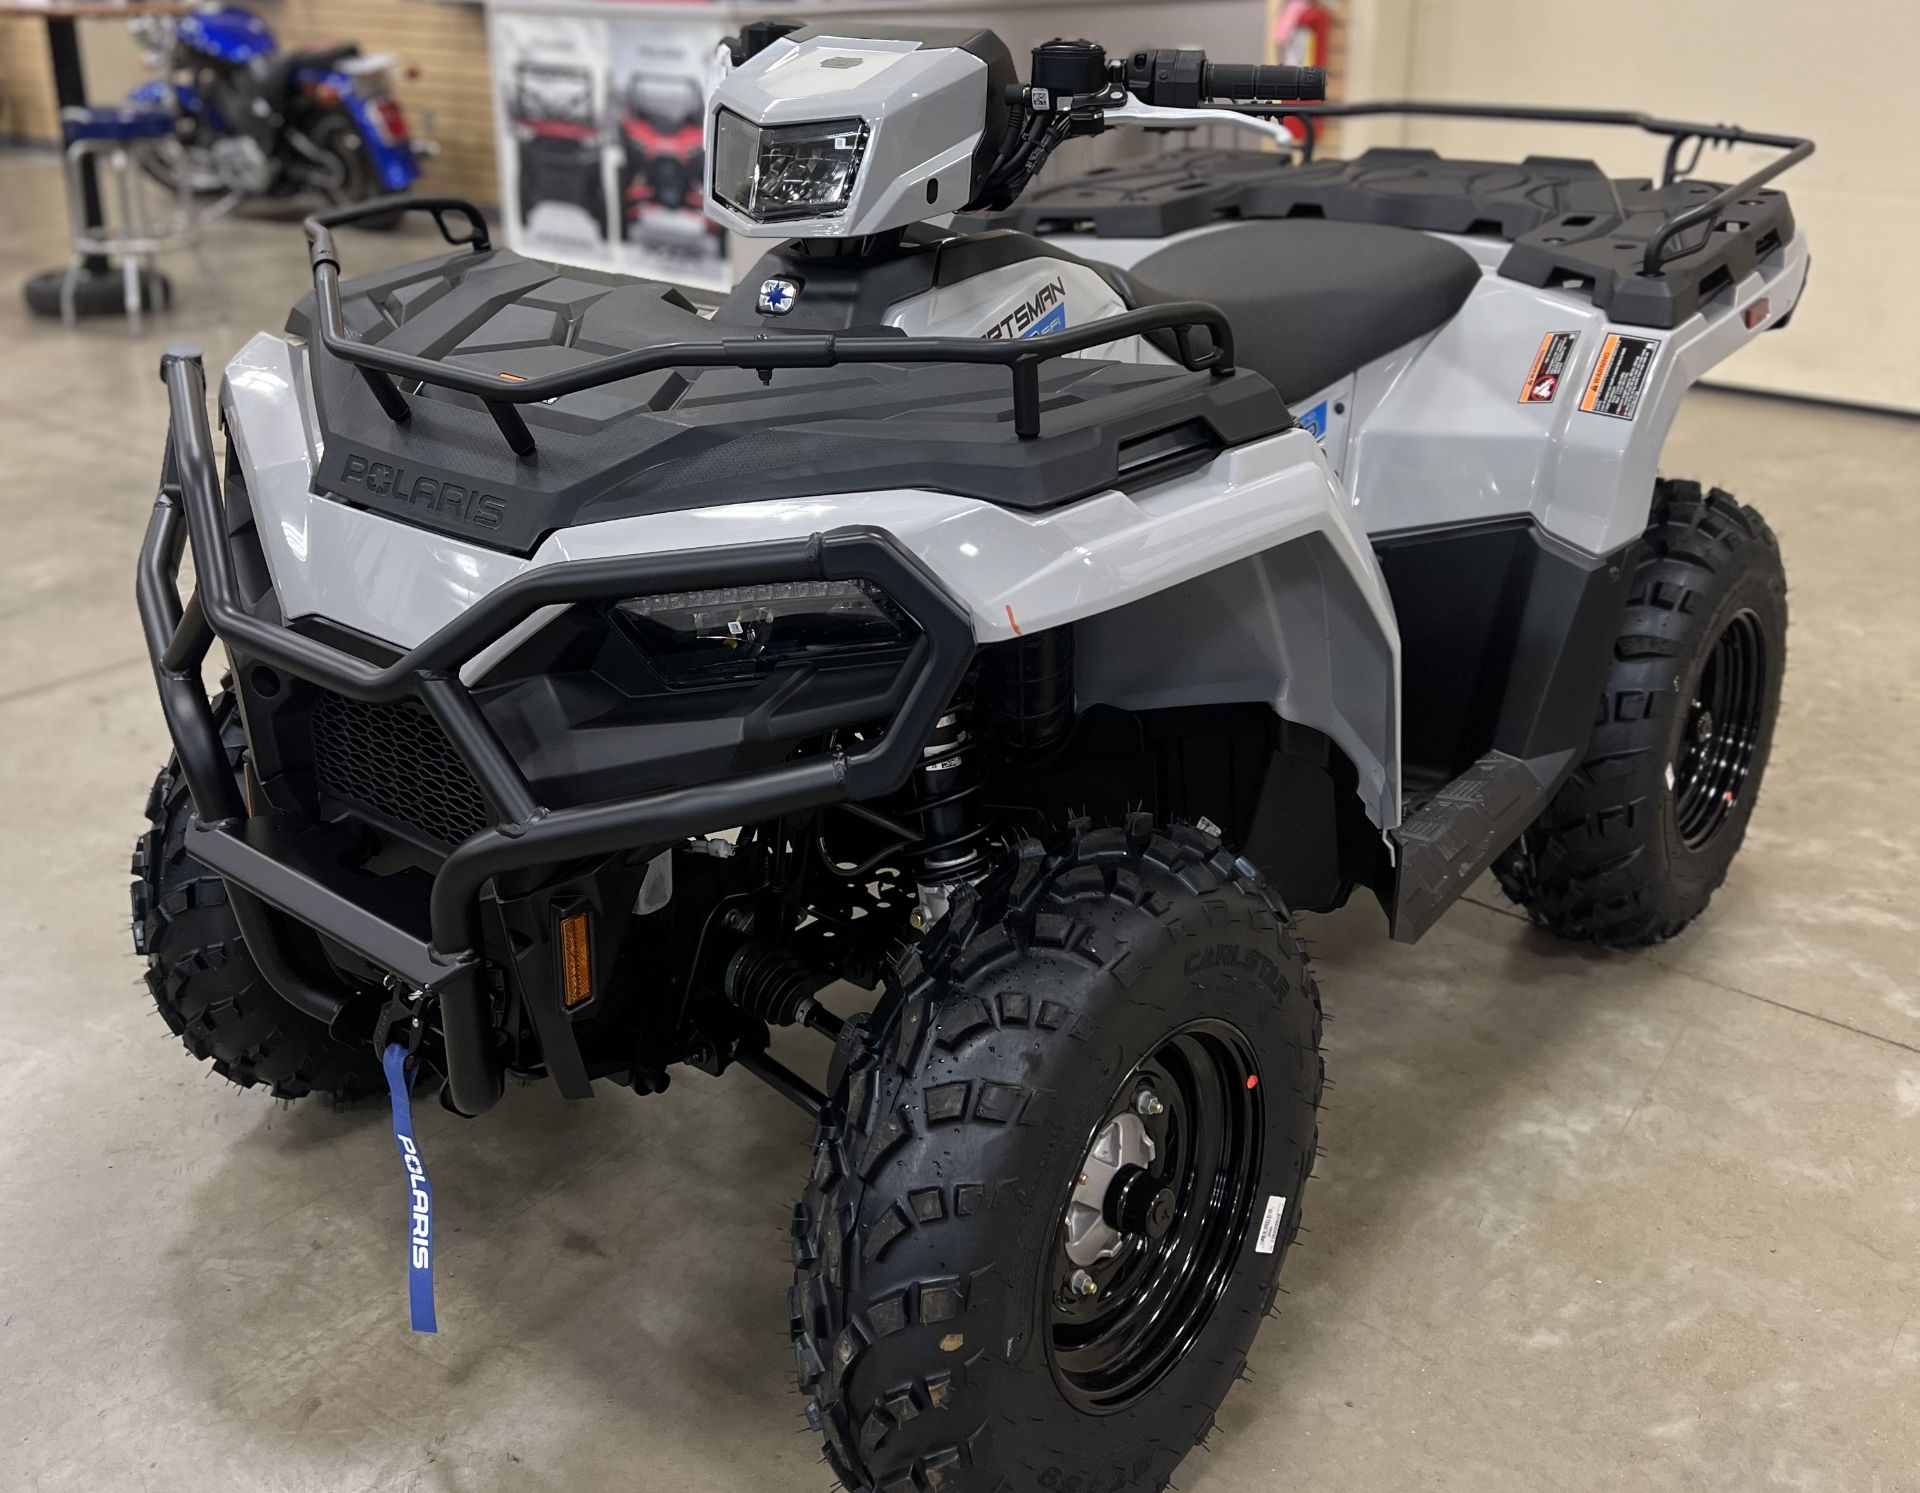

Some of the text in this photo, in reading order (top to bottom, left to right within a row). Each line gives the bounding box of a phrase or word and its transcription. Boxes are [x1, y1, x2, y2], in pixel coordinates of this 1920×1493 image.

[980, 277, 1066, 339] RTSMAN
[1593, 350, 1611, 385] WARNING
[341, 454, 506, 530] POLARIS
[398, 1134, 429, 1269] POLARIS
